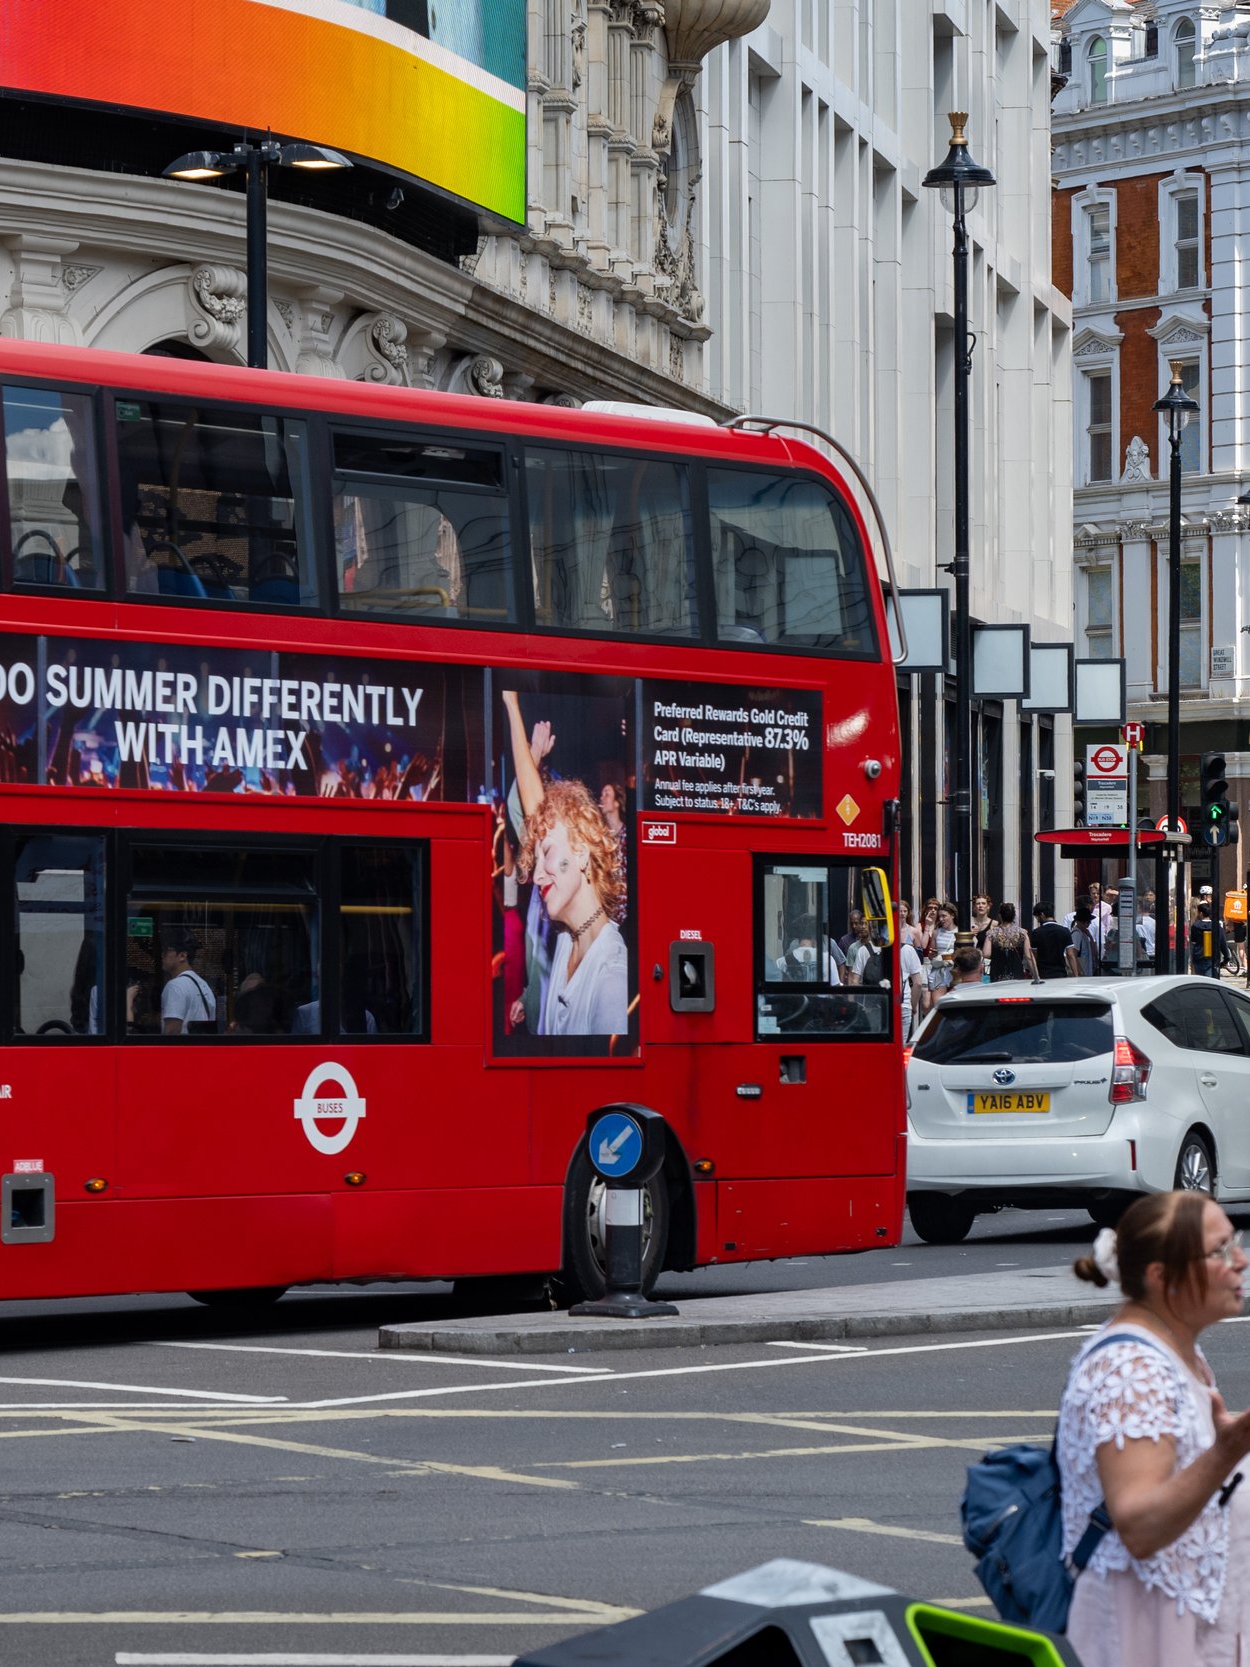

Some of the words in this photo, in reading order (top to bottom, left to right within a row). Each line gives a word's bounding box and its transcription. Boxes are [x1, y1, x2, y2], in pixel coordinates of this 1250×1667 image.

[46, 664, 198, 714] SUMMER
[208, 675, 424, 727] DIFFERENTLY
[654, 701, 703, 720] Preferred
[705, 705, 749, 722] Rewards
[750, 708, 775, 725] Gold
[776, 710, 809, 727] Credit
[654, 726, 679, 742] Card
[681, 728, 763, 747] (Representative
[764, 727, 809, 750] 87.3%
[1126, 725, 1140, 742] H
[114, 721, 203, 765] WITH
[212, 726, 309, 770] AMEX
[654, 750, 677, 766] APR
[678, 752, 726, 772] Variable)
[654, 778, 681, 791] Annual
[681, 779, 694, 791] fee
[694, 781, 722, 795] applies
[723, 782, 741, 794] after
[654, 794, 683, 810] Subject
[684, 796, 693, 807] to
[648, 825, 670, 840] global
[842, 832, 881, 848] TEH2081
[680, 930, 702, 941] DIESEL
[317, 1102, 343, 1114] BUSES
[980, 1094, 1011, 1110] YA16
[1015, 1094, 1045, 1109] ABV
